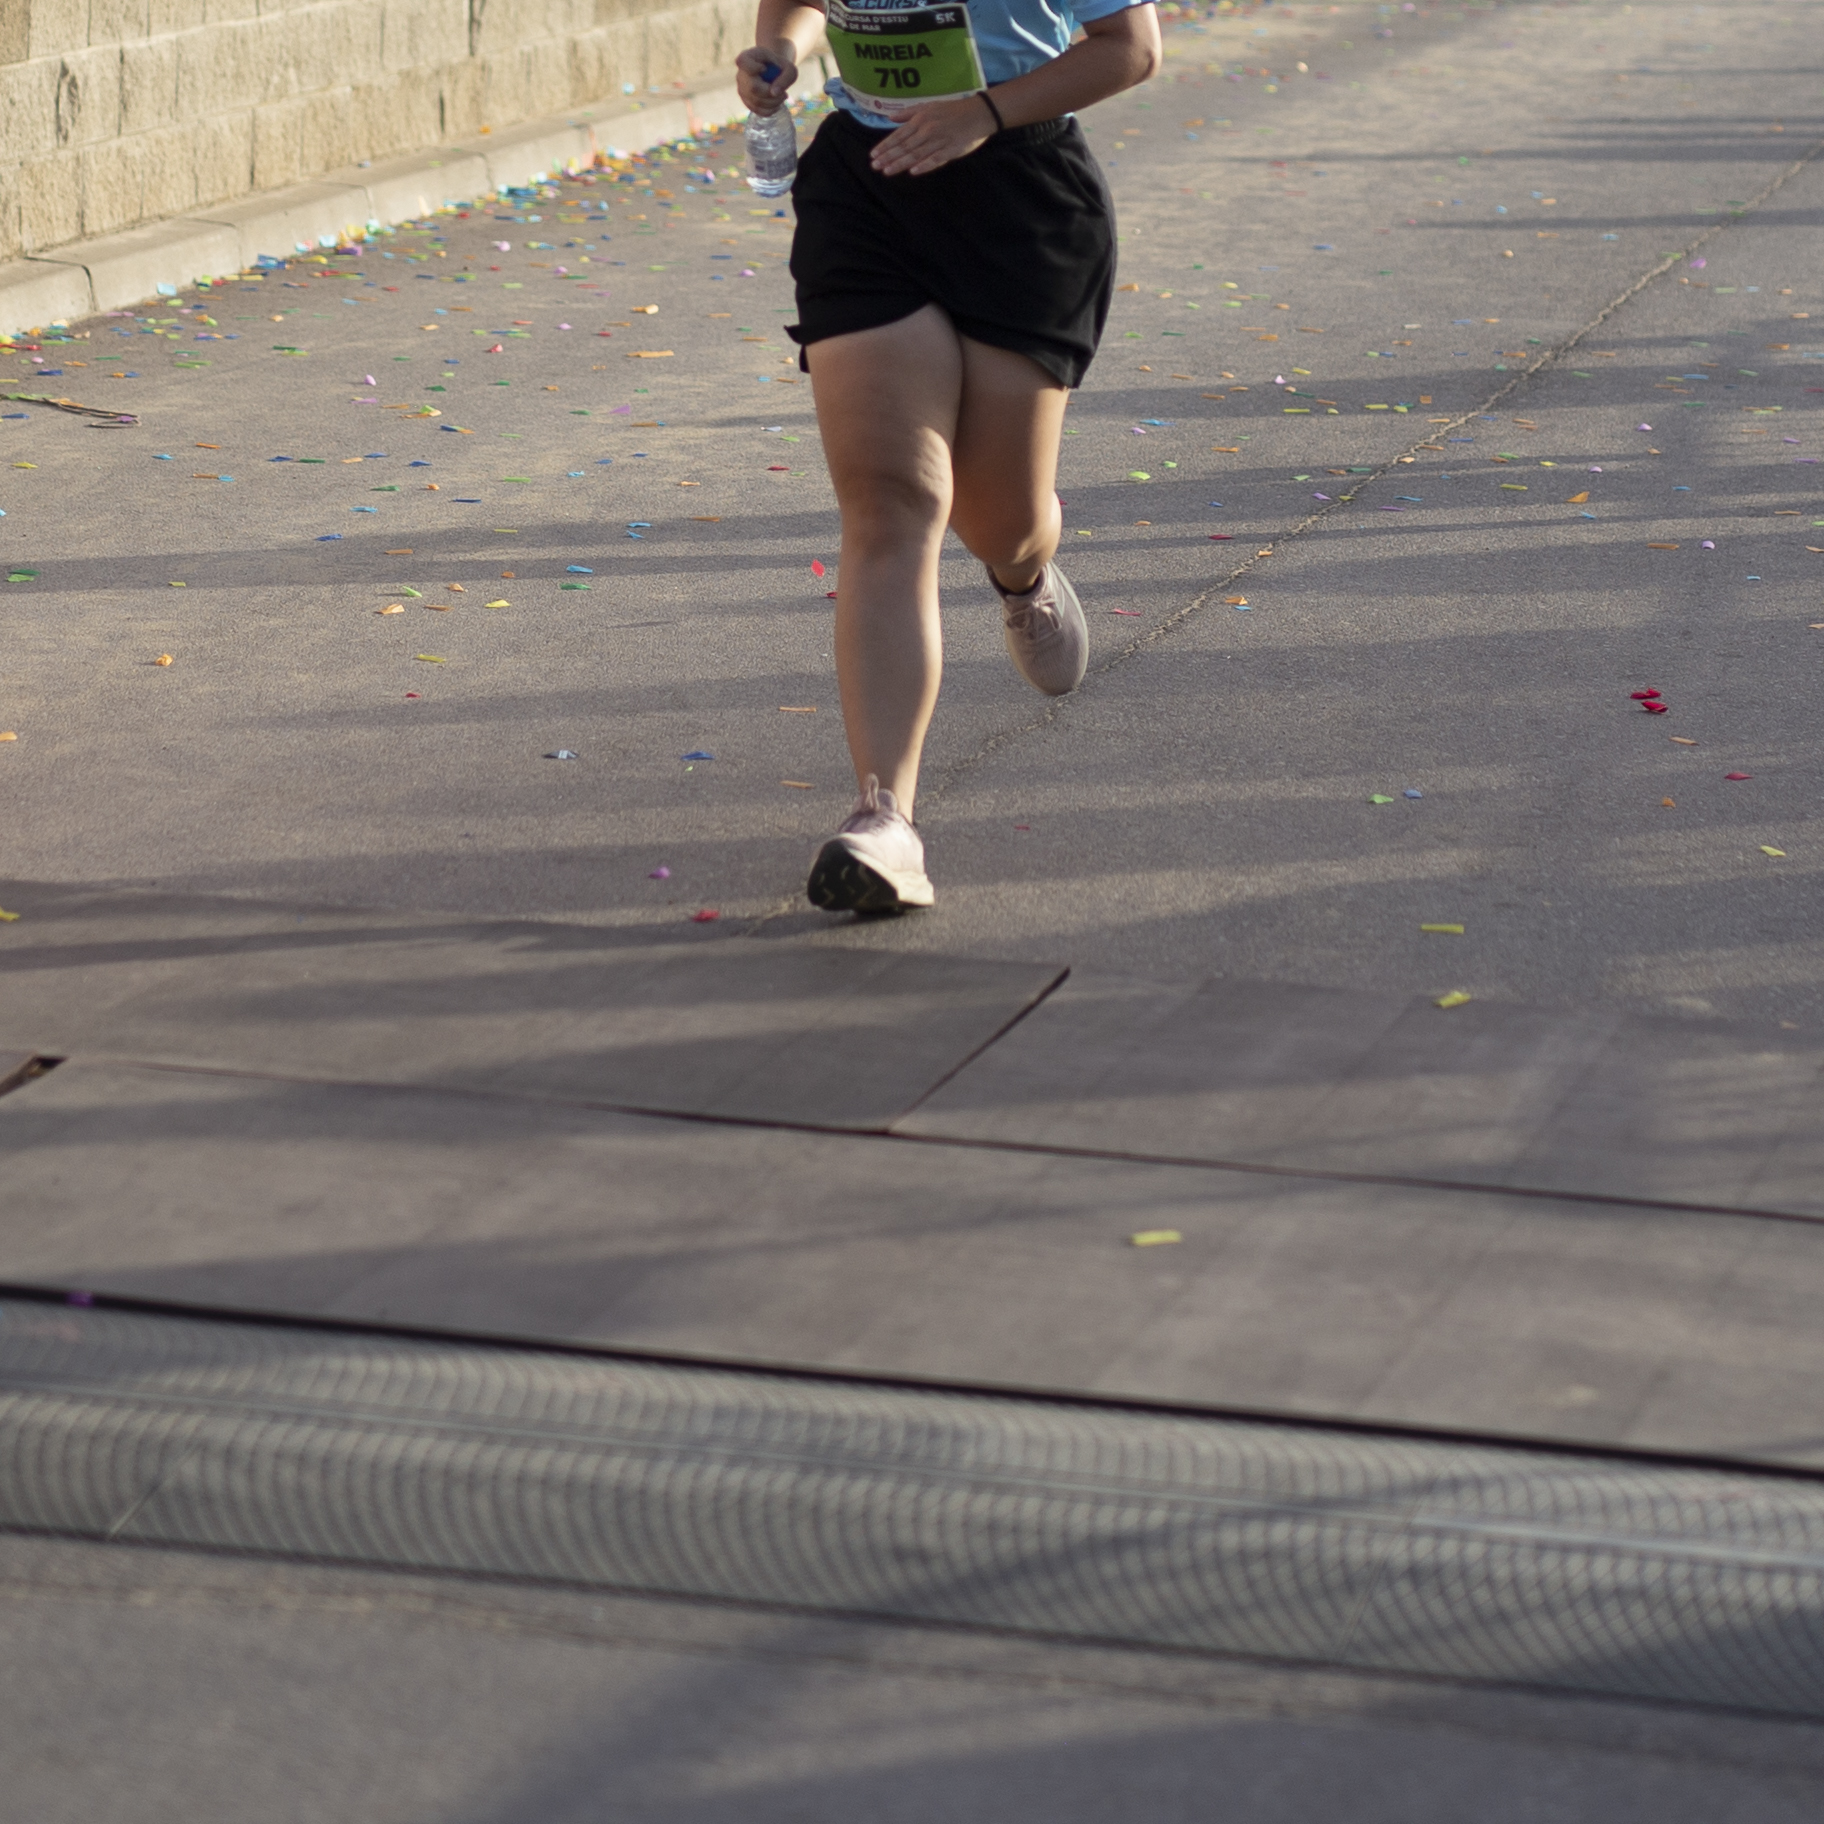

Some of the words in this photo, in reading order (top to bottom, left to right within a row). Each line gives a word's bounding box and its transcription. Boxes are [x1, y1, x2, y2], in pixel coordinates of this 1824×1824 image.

[935, 11, 957, 24] 5K
[854, 42, 934, 61] MIREIA
[874, 67, 922, 89] 710
